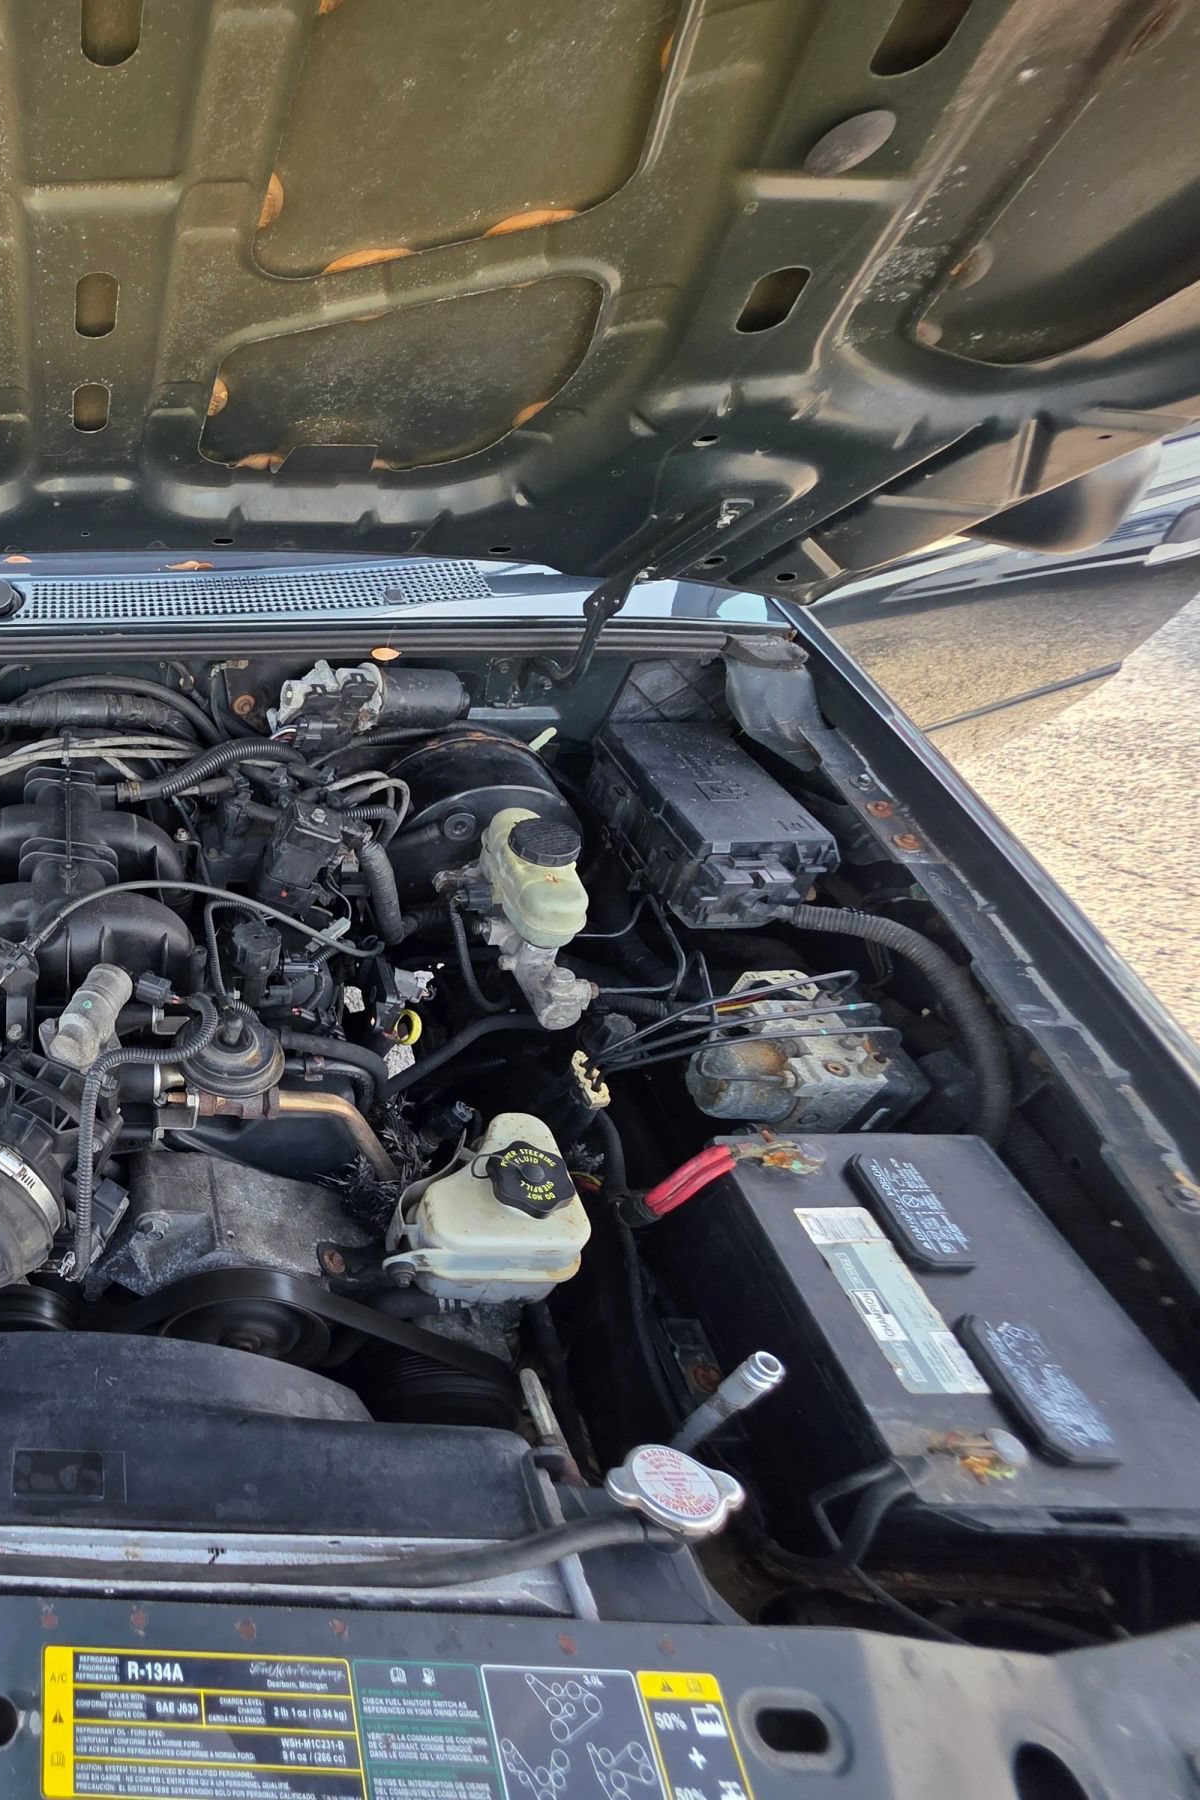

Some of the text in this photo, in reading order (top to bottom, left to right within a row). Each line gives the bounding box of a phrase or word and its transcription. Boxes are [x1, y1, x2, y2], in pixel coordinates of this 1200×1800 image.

[514, 1155, 539, 1165] FLUID
[519, 1148, 557, 1168] STEERING
[869, 1164, 895, 1196] POISON
[520, 1180, 555, 1194] OVERFILL
[526, 1192, 557, 1201] DO NOT
[861, 1292, 894, 1337] CHAMPION
[640, 1449, 683, 1461] WARNING
[127, 1660, 184, 1682] R-134A
[250, 1661, 298, 1678] Ford Motor
[50, 1673, 68, 1684] A/C
[582, 1674, 606, 1689] 3.0L
[267, 1679, 328, 1691] Dearborn, Michigan
[100, 1692, 129, 1700] COMPLIES
[219, 1696, 243, 1705] CHARGE
[155, 1701, 199, 1715] SAE J639
[362, 1697, 468, 1709] CHECK FUEL SHUTOFF SWITCH AS
[108, 1710, 131, 1718] CUMPLE
[273, 1706, 348, 1721] 2 lb 1 oz (0.94 kg)
[363, 1706, 405, 1715] REFERENCED
[415, 1707, 433, 1717] YOUR
[433, 1708, 458, 1718] OWNER
[653, 1711, 688, 1732] 50%
[75, 1726, 115, 1736] REFRIGERANT
[406, 1733, 443, 1743] COMMANDE
[297, 1753, 307, 1762] oz
[369, 1750, 387, 1758] DANS
[398, 1751, 419, 1760] GUIDE
[104, 1764, 128, 1773] SYSTEM
[129, 1765, 137, 1773] TO
[147, 1766, 177, 1775] SERVICED
[186, 1768, 217, 1777] QUALIFIED
[225, 1780, 261, 1789] PERSONNEL
[407, 1779, 455, 1789] INTERRUPTOR
[674, 1786, 708, 1800] 50%
